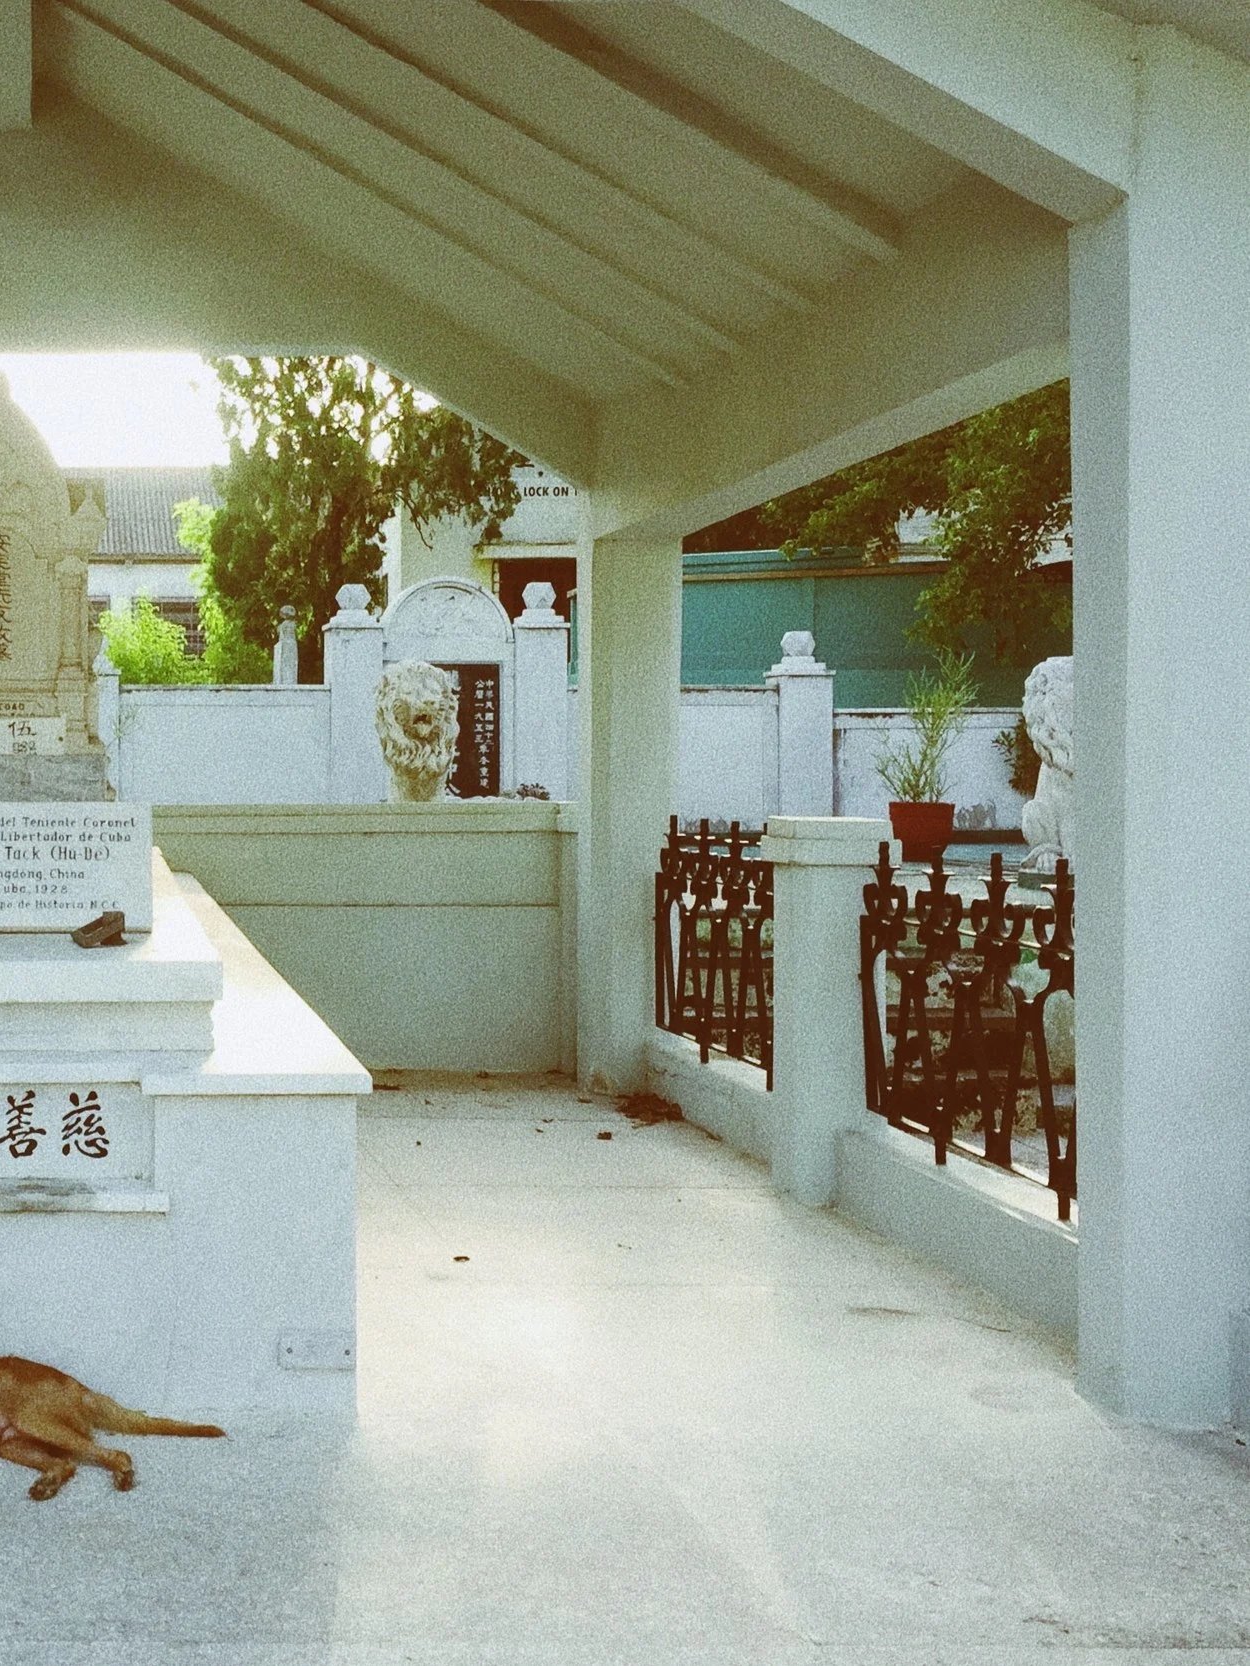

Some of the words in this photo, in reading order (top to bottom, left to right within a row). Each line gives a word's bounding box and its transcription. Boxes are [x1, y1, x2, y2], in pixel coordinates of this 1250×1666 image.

[523, 486, 550, 497] LOCK
[553, 486, 570, 497] ON
[8, 720, 38, 739] 伍
[22, 816, 77, 828] Teniente
[83, 816, 137, 828] Coronel
[0, 831, 73, 843] Libertador
[78, 831, 94, 842] de
[99, 831, 132, 843] Cuba
[4, 846, 41, 861] Tack
[50, 845, 111, 862] (Hu-De)
[49, 868, 86, 880] China
[18, 899, 31, 909] de
[35, 899, 85, 910] Historia
